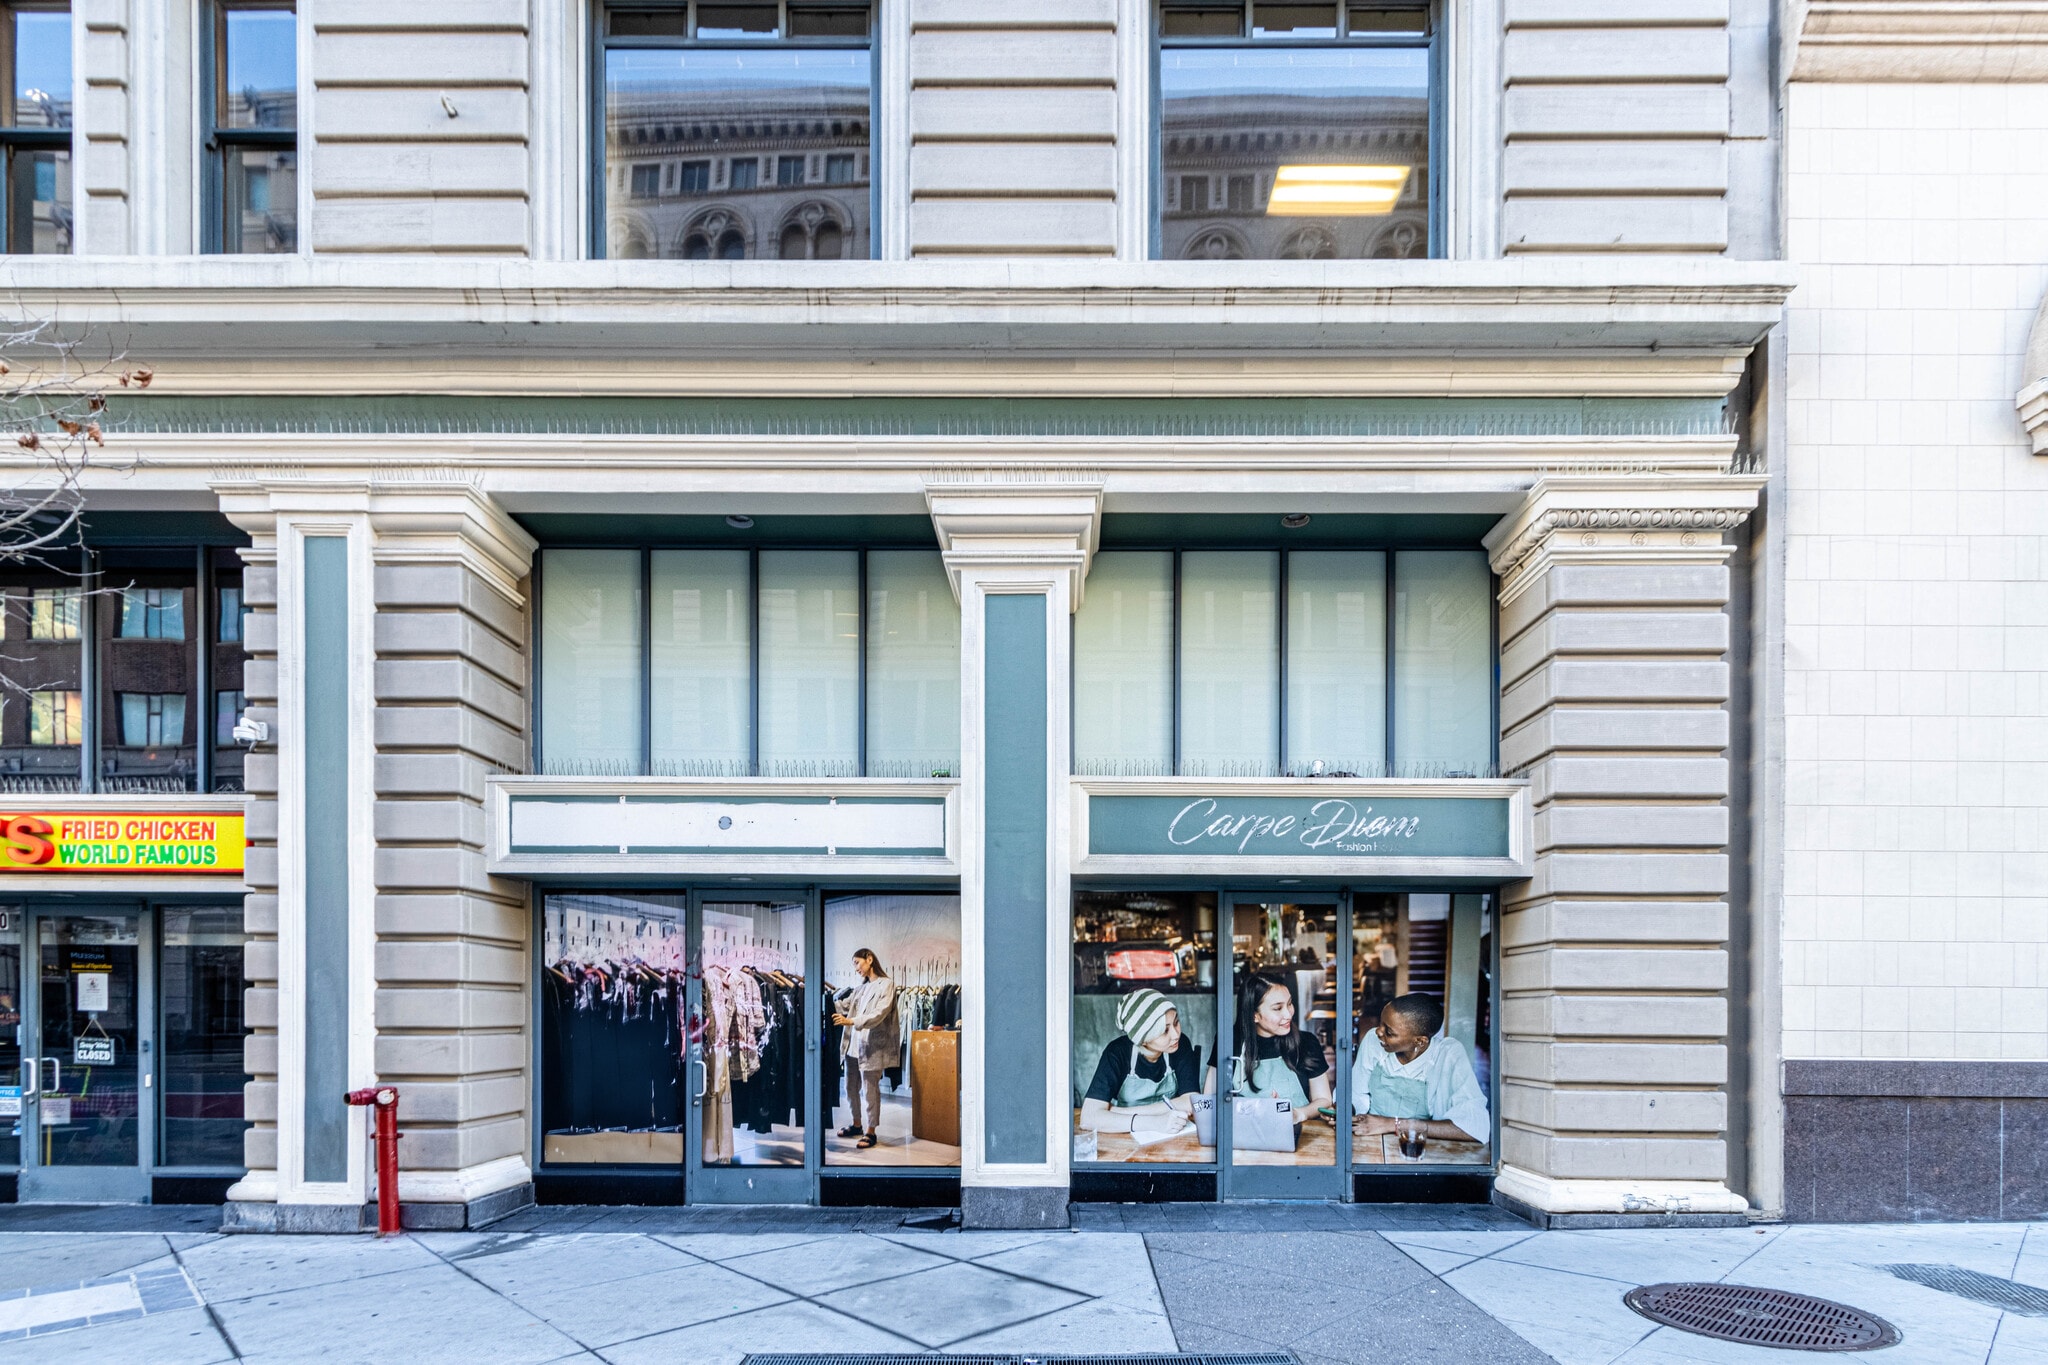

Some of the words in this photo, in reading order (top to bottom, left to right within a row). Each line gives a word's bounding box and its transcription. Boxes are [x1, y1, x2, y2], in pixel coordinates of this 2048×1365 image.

[62, 820, 121, 840] FRIED
[126, 820, 216, 841] CHICKEN
[1168, 798, 1297, 854] Carpe
[1300, 799, 1420, 850] Diem
[59, 844, 130, 864] WORLD
[135, 844, 217, 865] FAMOUS
[1336, 841, 1372, 852] Fashion
[77, 1050, 111, 1061] CLOSED
